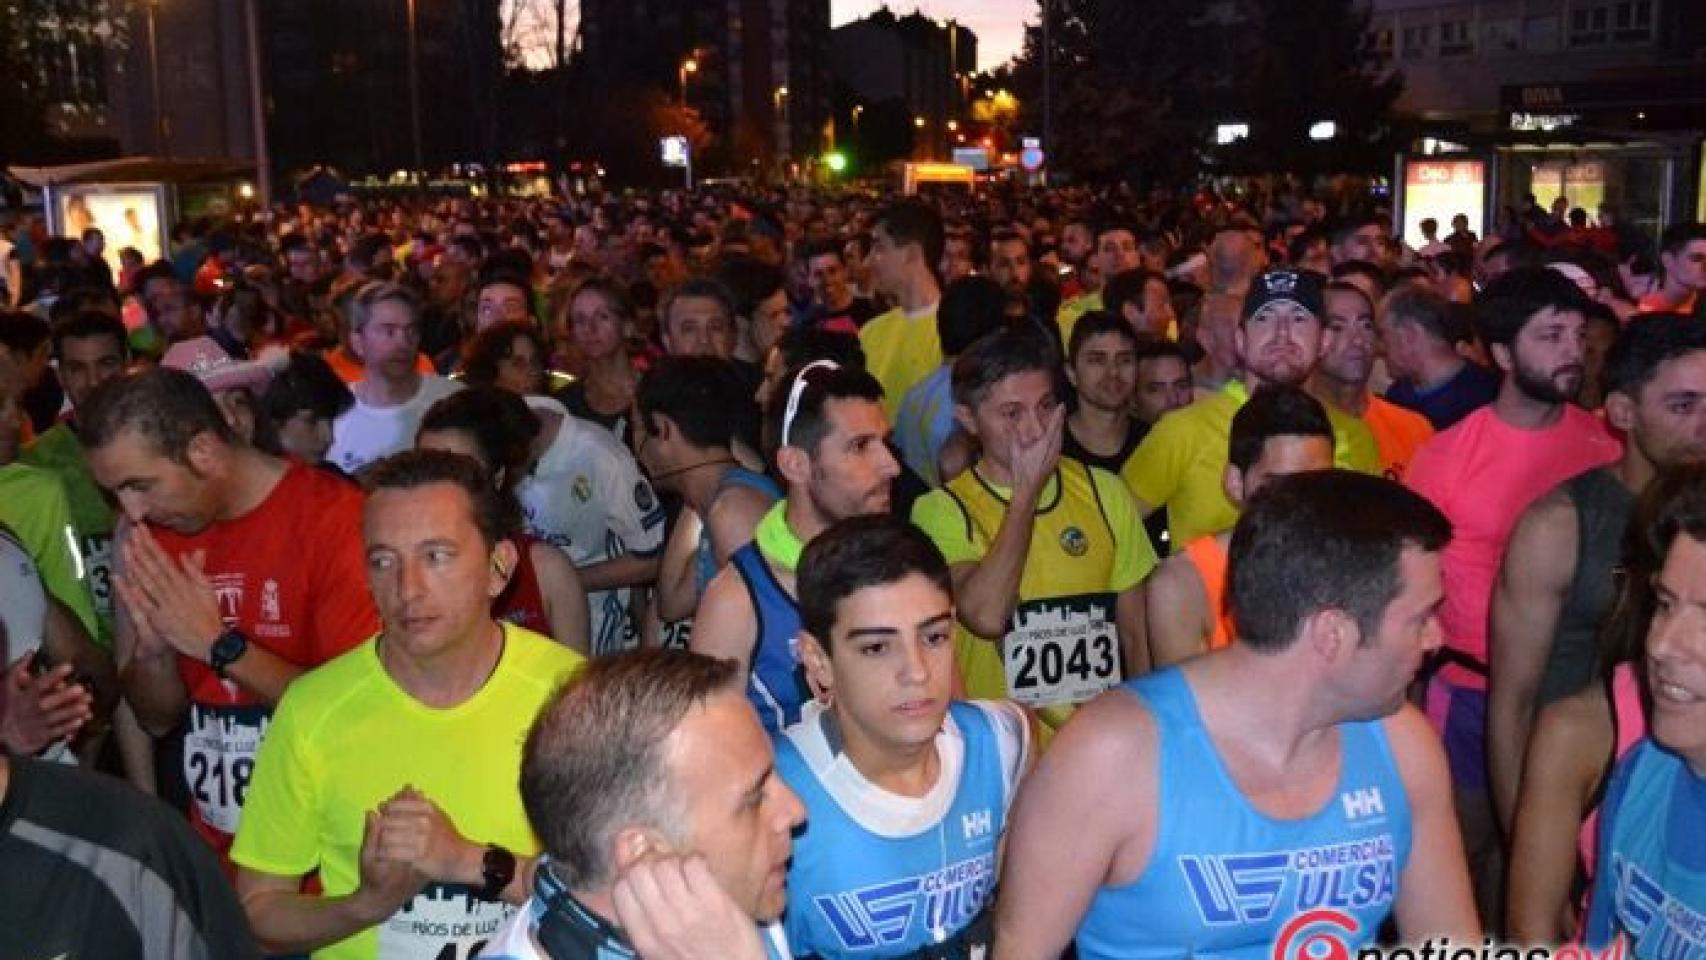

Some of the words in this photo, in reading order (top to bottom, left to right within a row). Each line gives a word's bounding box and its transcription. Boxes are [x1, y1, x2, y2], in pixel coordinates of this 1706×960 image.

[1012, 635, 1114, 688] 2043
[1341, 786, 1384, 819] HH
[962, 809, 992, 839] HH
